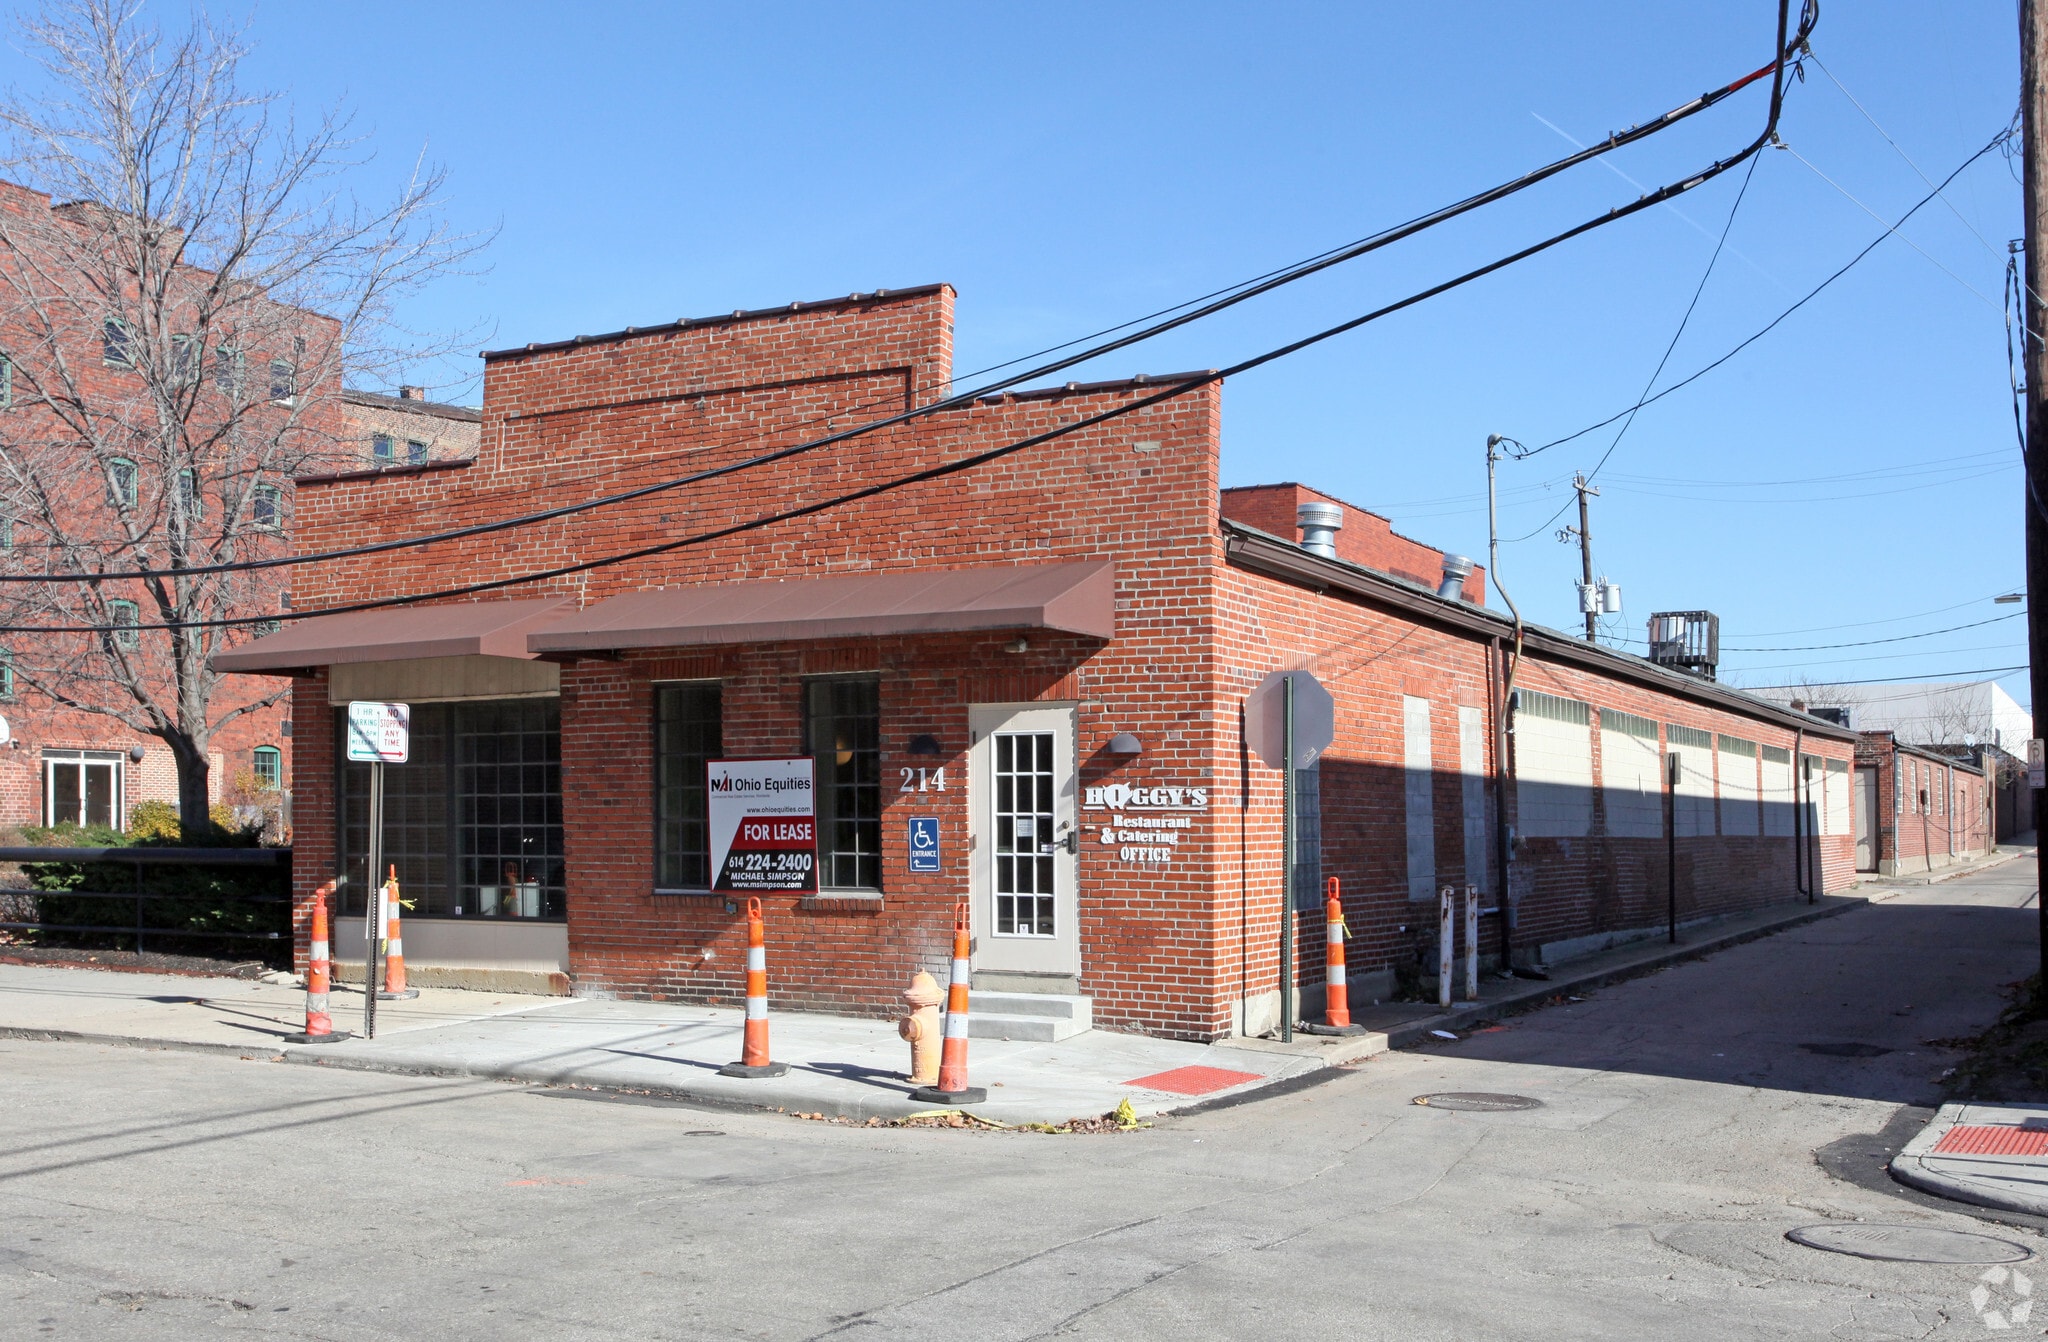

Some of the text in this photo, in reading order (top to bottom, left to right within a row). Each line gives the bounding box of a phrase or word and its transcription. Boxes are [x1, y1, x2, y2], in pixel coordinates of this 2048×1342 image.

[388, 708, 398, 718] NO
[380, 719, 406, 728] STOPPING
[384, 738, 400, 746] TIME
[711, 774, 811, 794] NAI Ohio Equities
[900, 766, 946, 792] 214
[1084, 782, 1208, 810] HOGGY'S
[746, 806, 811, 814] www.ohioequities.com
[1112, 814, 1192, 828] Restaurant
[744, 824, 812, 841] FOR LEASE
[1100, 827, 1178, 845] & Catering
[1120, 847, 1171, 862] OFFICE
[729, 854, 812, 871] 614 224-2400
[730, 872, 805, 881] MICHAEL SIMPSON
[732, 881, 802, 890] www.msimpson.com
